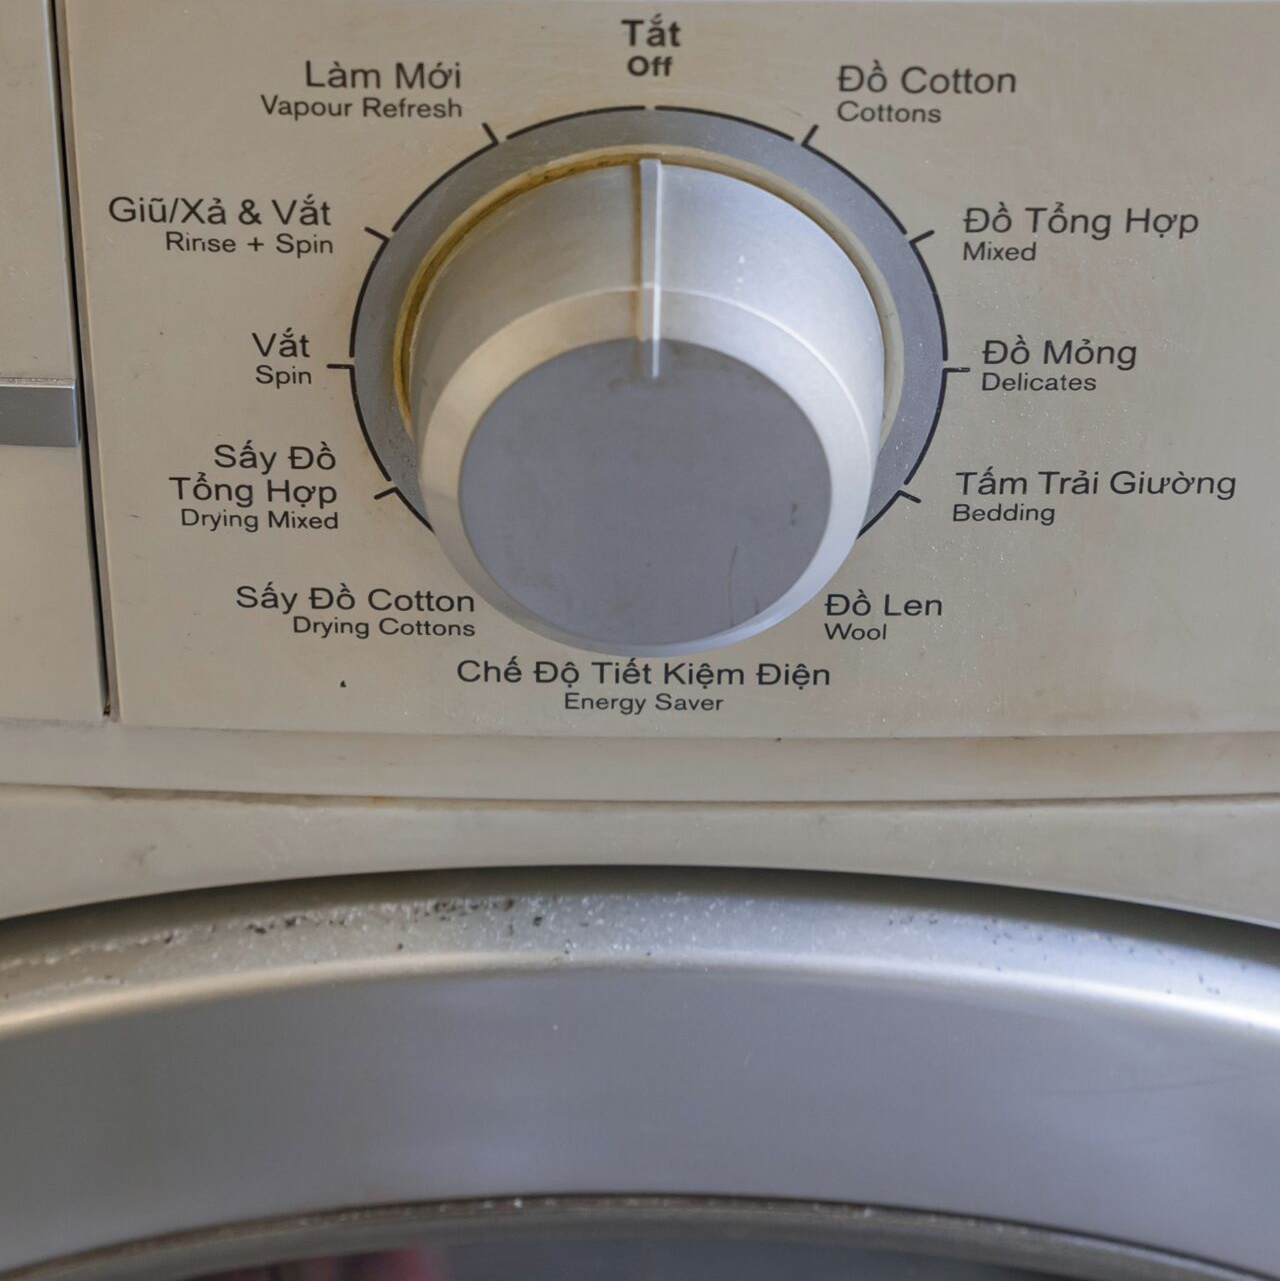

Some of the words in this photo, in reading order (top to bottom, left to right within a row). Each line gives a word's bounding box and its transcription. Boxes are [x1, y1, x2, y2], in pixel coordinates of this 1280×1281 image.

[620, 13, 681, 48] Tắt
[305, 60, 381, 89] Làm
[395, 61, 461, 90] Mới
[627, 55, 673, 77] Off
[837, 59, 888, 93] Đồ
[900, 65, 1017, 95] Cotton
[260, 94, 353, 122] Vapour
[362, 96, 462, 119] Refresh
[836, 100, 942, 124] Cottons
[238, 198, 263, 226] &
[271, 193, 332, 226] Vắt
[963, 201, 1012, 234] Đồ
[1024, 201, 1112, 241] Tổng
[1125, 207, 1199, 240] Hợp
[165, 230, 237, 253] Rinse
[247, 236, 265, 252] +
[275, 232, 334, 259] Spin
[963, 241, 1037, 262] Mixed
[251, 327, 311, 358] Vắt
[981, 334, 1030, 365] Đồ
[1043, 338, 1137, 371] Mỏng
[255, 364, 312, 390] Spin
[981, 372, 1097, 392] Delicates
[214, 439, 278, 476] Sấy
[287, 440, 336, 471] Đồ
[168, 471, 254, 509] Tổng
[267, 479, 338, 510] Hợp
[955, 465, 1028, 496] Tấm
[1037, 469, 1099, 495] Trải
[1109, 470, 1236, 501] Giường
[181, 508, 259, 533] Drying
[267, 510, 339, 530] Mixed
[952, 502, 1055, 527] Bedding
[236, 581, 298, 615] Sấy
[308, 582, 356, 611] Đồ
[367, 588, 475, 613] Cotton
[824, 588, 872, 617] Đồ
[884, 593, 943, 617] Len
[293, 615, 370, 640] Drying
[378, 617, 476, 637] Cottons
[823, 622, 887, 641] Wool
[456, 655, 522, 683] Chế
[533, 660, 580, 689] Độ
[591, 657, 652, 685] Tiết
[664, 662, 745, 690] Kiệm
[755, 663, 830, 691] Điện
[564, 692, 647, 716] Energy
[655, 692, 724, 712] Saver
